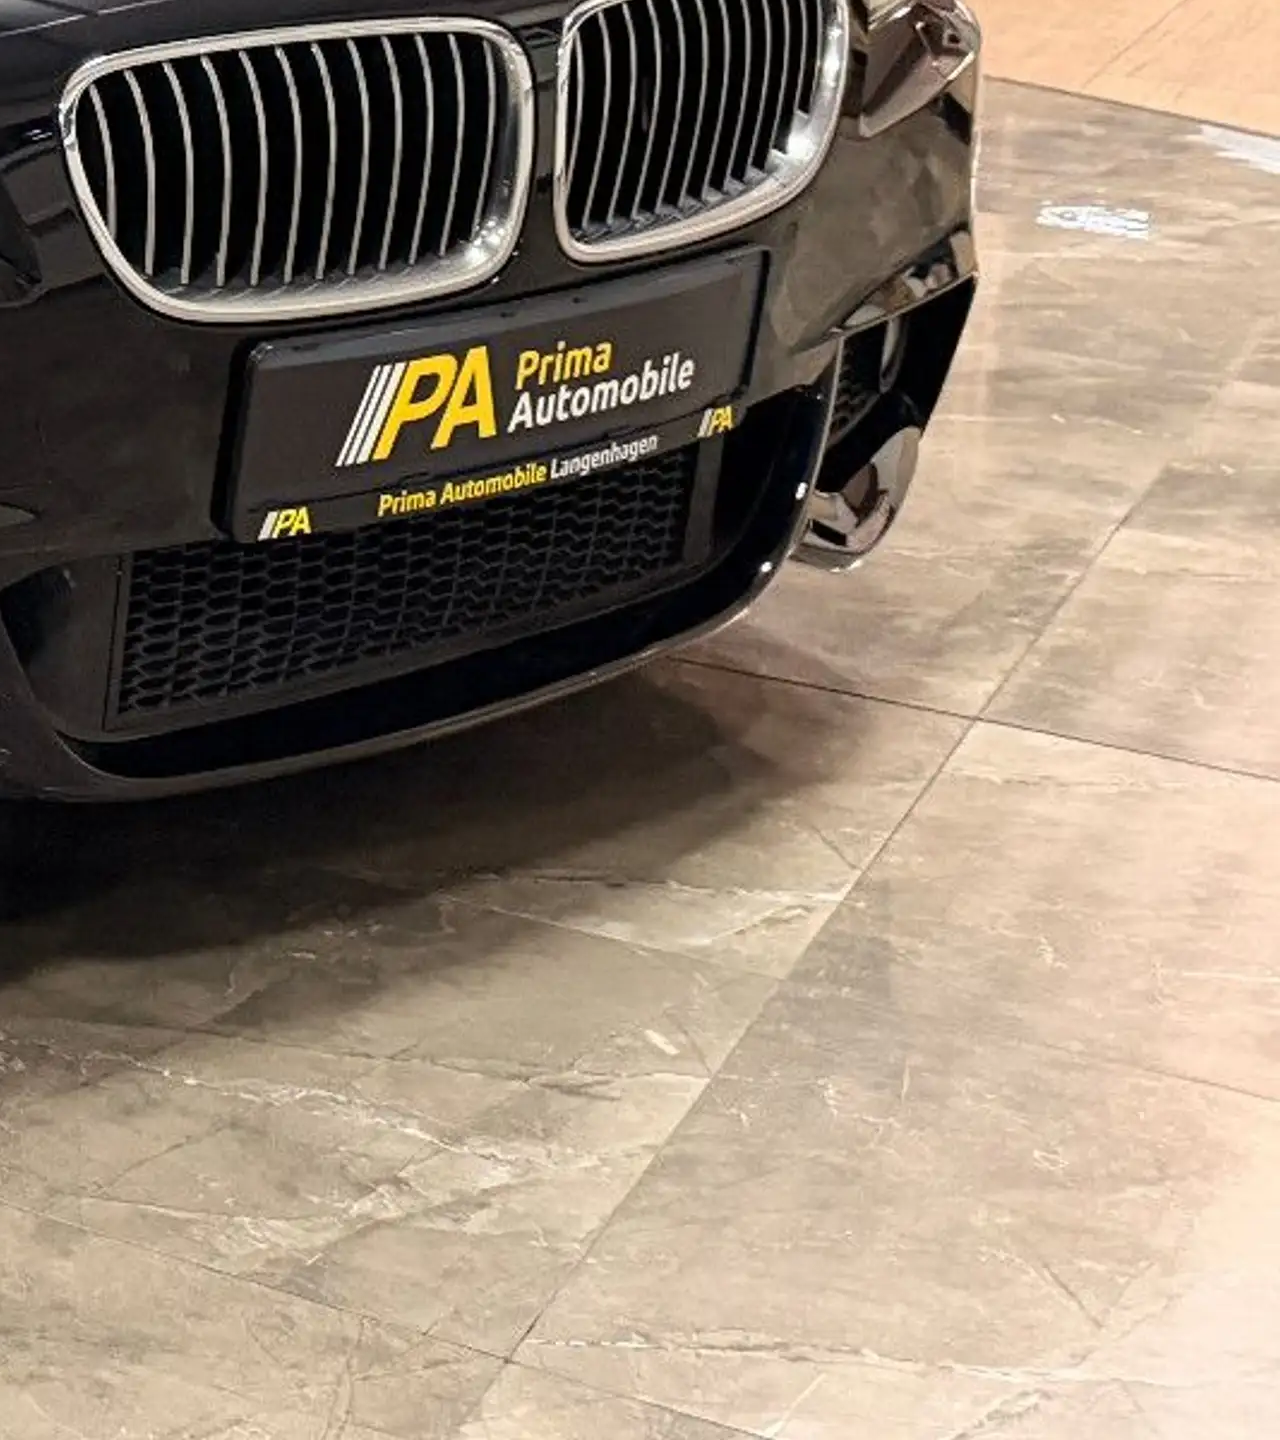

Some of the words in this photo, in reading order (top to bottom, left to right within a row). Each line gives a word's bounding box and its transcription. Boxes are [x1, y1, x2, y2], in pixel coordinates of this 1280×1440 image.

[507, 351, 696, 433] Automobile
[515, 341, 613, 390] Prima
[373, 345, 497, 461] PA
[705, 406, 735, 436] PA
[377, 492, 437, 517] Prima
[439, 462, 547, 506] Automobile
[549, 435, 660, 479] Langenhagen
[272, 506, 312, 539] PA
